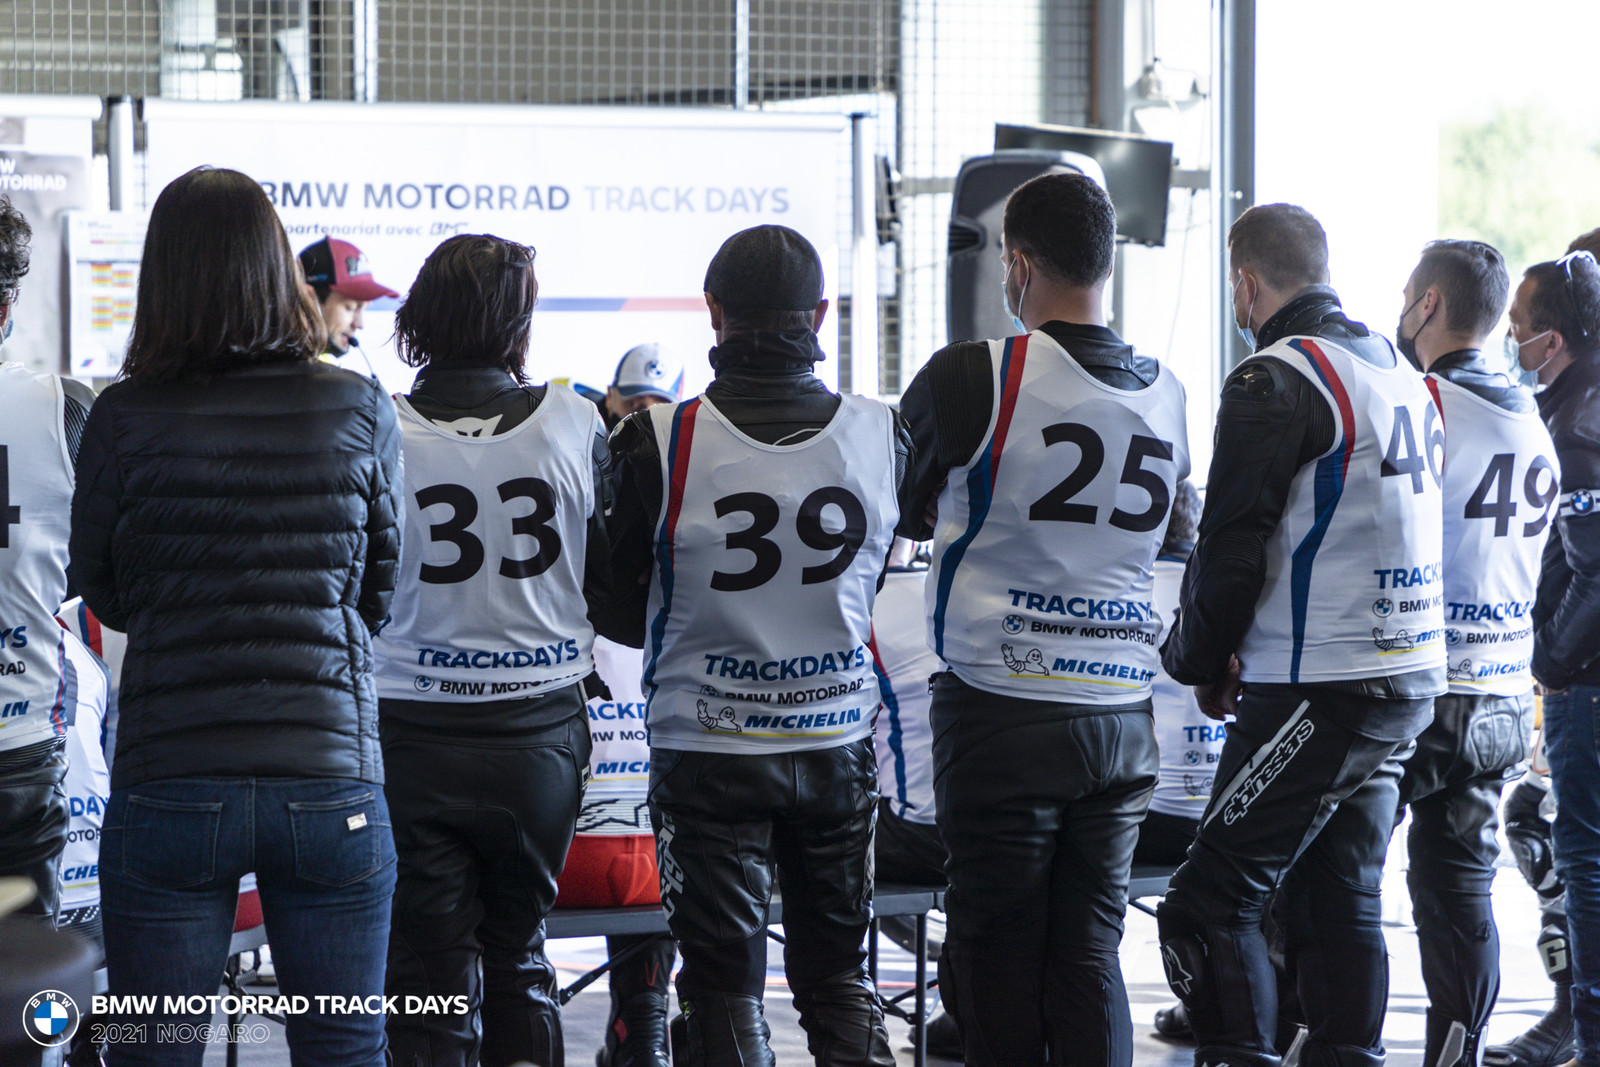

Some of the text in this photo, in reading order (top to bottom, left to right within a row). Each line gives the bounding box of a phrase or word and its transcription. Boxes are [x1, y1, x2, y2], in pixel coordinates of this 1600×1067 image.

[0, 173, 67, 191] TORRAD
[261, 181, 790, 214] BMW MOTORRAD TRACK DAYS
[386, 225, 423, 236] avec
[1380, 400, 1445, 495] 46
[1028, 422, 1174, 533] 25
[1464, 453, 1558, 538] 49
[414, 476, 562, 585] 33
[709, 485, 867, 592] 39
[1374, 561, 1442, 590] TRACK
[1008, 588, 1153, 622] TRACKDAY
[1400, 597, 1431, 614] BMW
[1030, 620, 1077, 635] BMW
[1080, 626, 1156, 646] MOTORRAD
[1466, 632, 1500, 645] BMW
[417, 638, 580, 669] TRACKDAYS
[704, 645, 865, 682] TRACKDAYS
[439, 681, 486, 696] BMW
[725, 677, 864, 705] BMW MOTORRAD
[744, 707, 861, 729] MICHELIN
[1224, 718, 1315, 826] alpinestars
